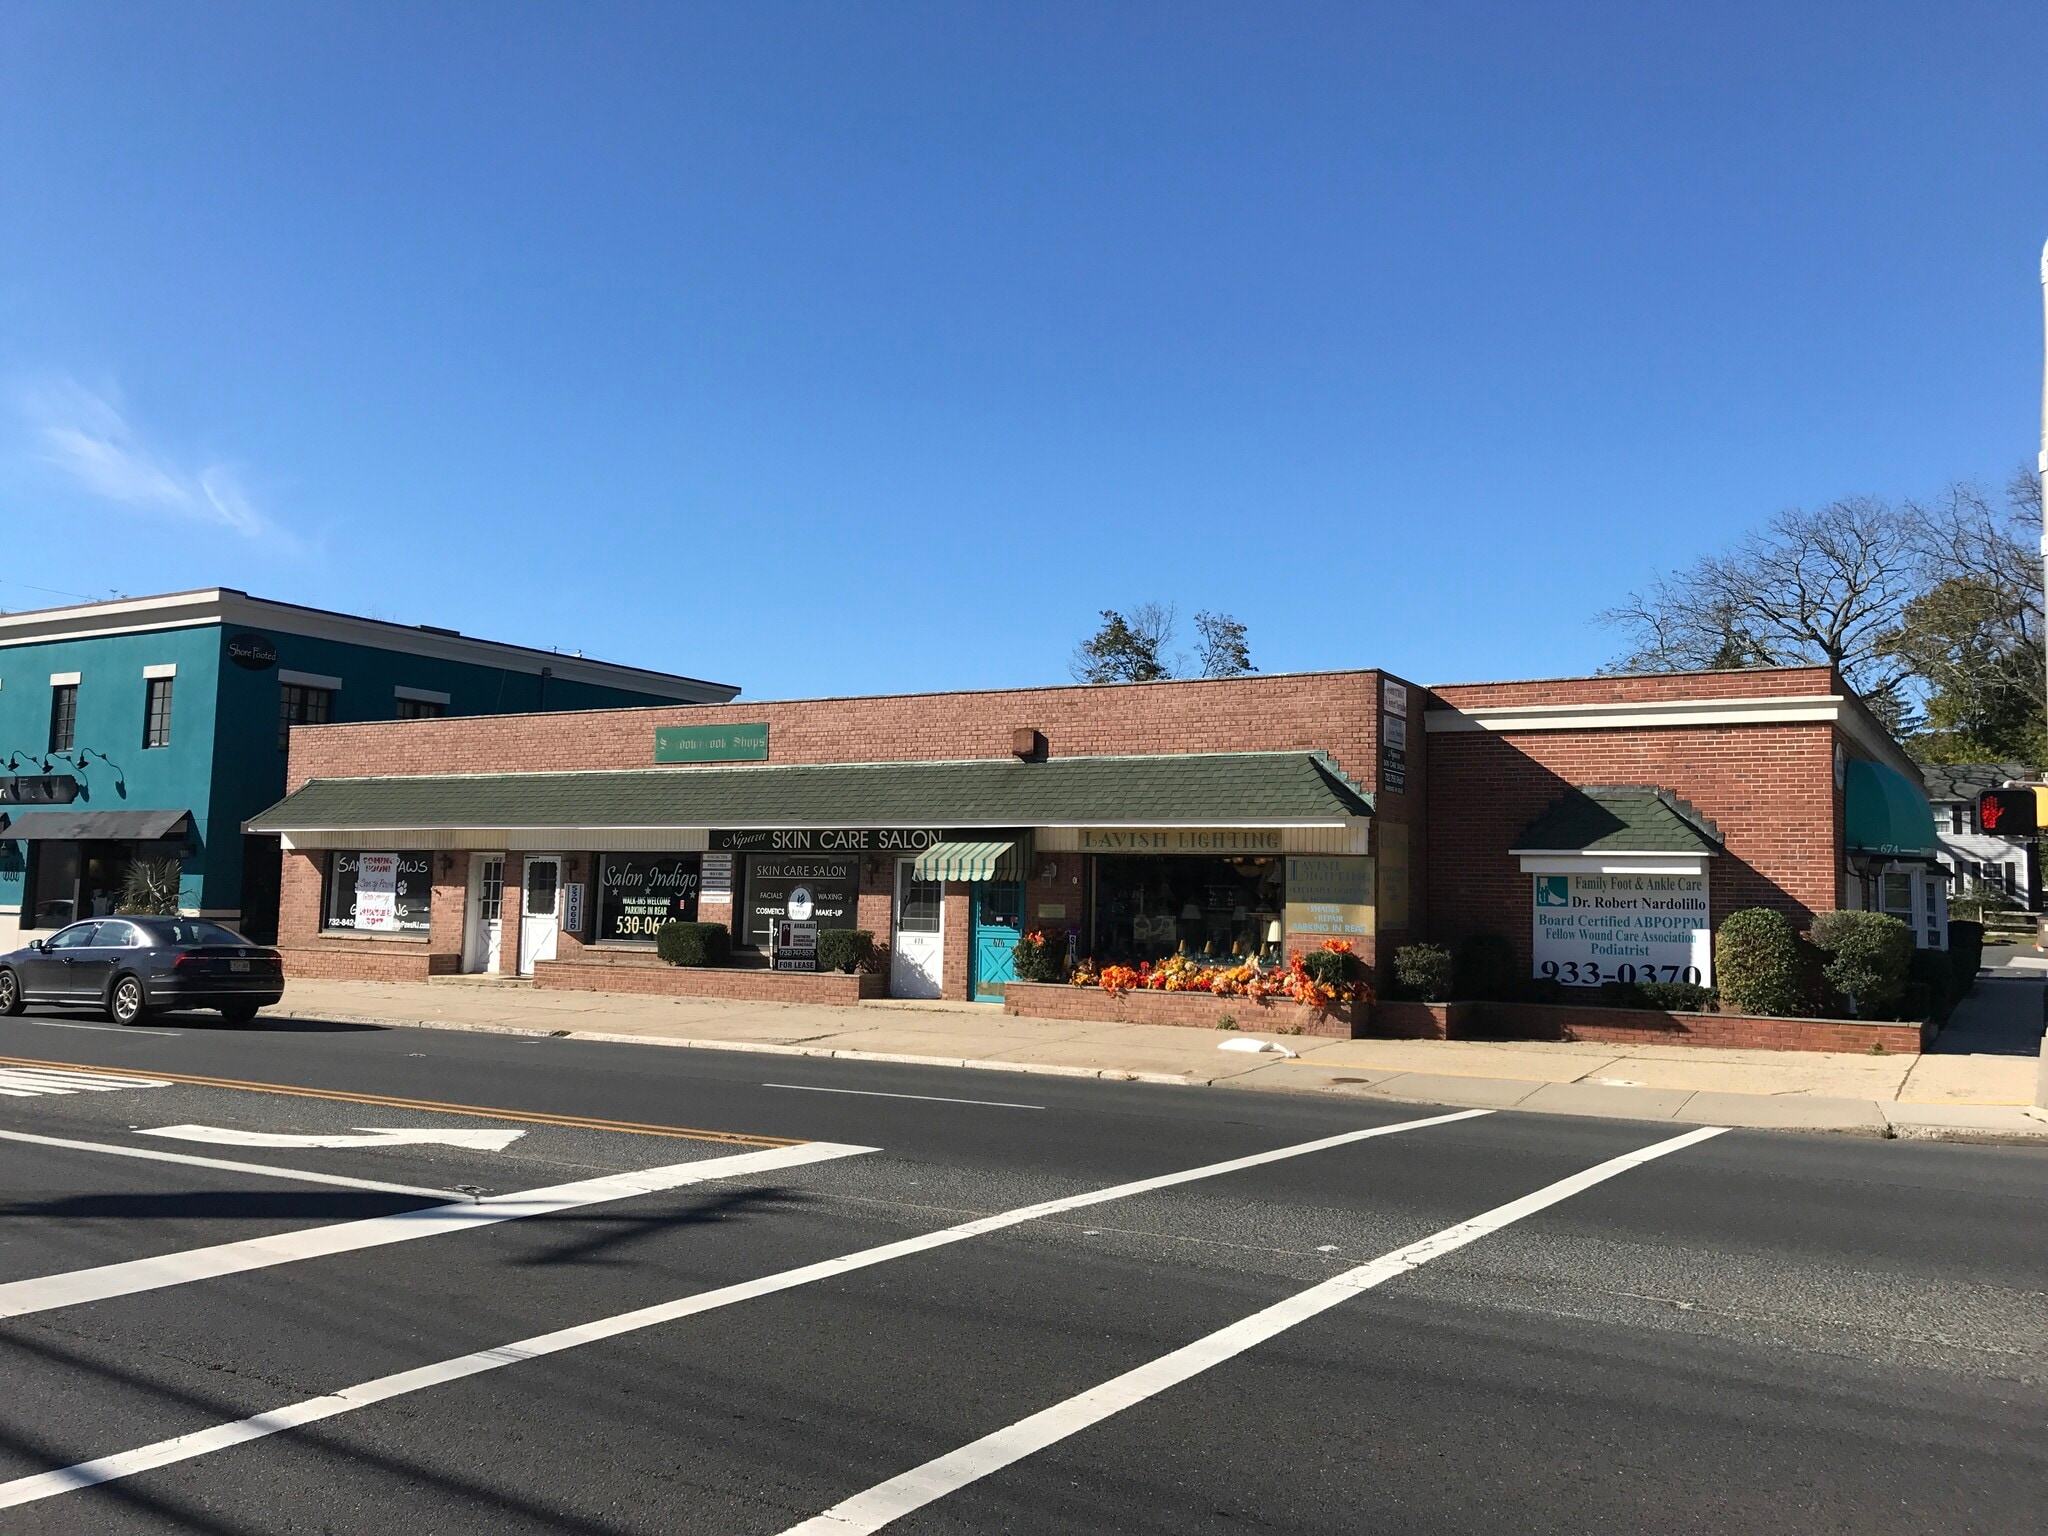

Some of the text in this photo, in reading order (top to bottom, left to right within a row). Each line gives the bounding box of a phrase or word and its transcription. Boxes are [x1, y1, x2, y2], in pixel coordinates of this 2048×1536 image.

[228, 643, 277, 661] Shore Footed
[733, 736, 766, 751] Shops
[771, 831, 811, 849] SKIN
[819, 831, 869, 849] CARE
[878, 831, 943, 849] SALON
[1084, 831, 1279, 849] LAVISH LIGHTING
[1880, 844, 1899, 854] 674
[756, 865, 847, 877] SKIN CARE SALON
[602, 862, 698, 896] Salon Indigo
[1575, 876, 1702, 893] Family Foot & Ankle Care
[570, 885, 579, 930] 530-0660
[622, 897, 671, 906] WALK-INS WELCOME
[1310, 905, 1340, 913] SHADES
[1572, 896, 1706, 911] Dr. Robert Nardolillo
[625, 906, 667, 915] PARKING IN REAR
[755, 907, 785, 915] COSMETICS
[815, 909, 843, 917] MAKE-UP
[1292, 923, 1329, 932] PARKING
[1332, 924, 1342, 932] IN
[1539, 914, 1704, 929] Board Certified ABPOPPM
[1546, 928, 1697, 943] Fellow Wound Care Association
[1591, 943, 1649, 956] Podiatrist
[779, 961, 793, 969] FOR
[1541, 960, 1702, 987] 933-0370
